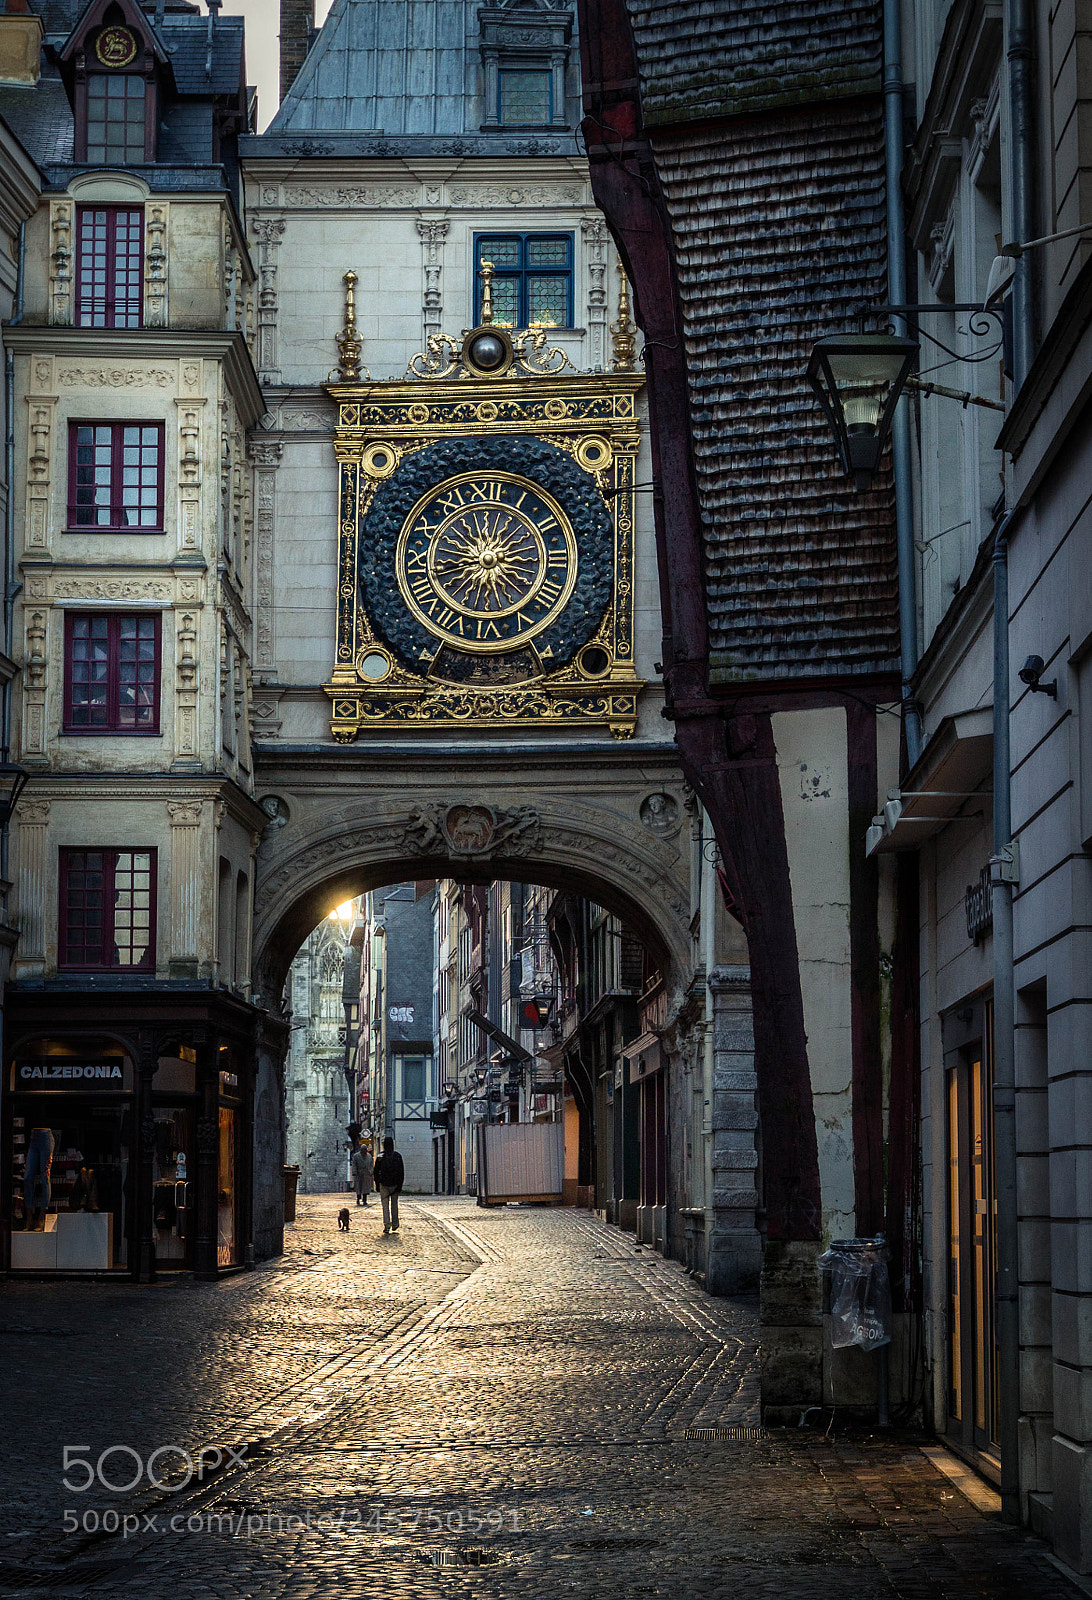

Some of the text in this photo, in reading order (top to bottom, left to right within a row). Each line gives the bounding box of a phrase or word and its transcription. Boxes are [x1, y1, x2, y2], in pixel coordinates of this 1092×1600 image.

[436, 488, 466, 517] XI
[469, 482, 502, 502] XII
[514, 491, 528, 509] I
[414, 515, 439, 539] X
[536, 514, 559, 533] II
[407, 548, 428, 574] IX
[547, 548, 568, 569] III
[410, 578, 439, 617] VIII
[535, 579, 563, 610] IIII
[435, 606, 465, 636] VII
[475, 619, 503, 640] VI
[515, 612, 535, 632] V
[20, 1065, 122, 1079] CALZEDONIA
